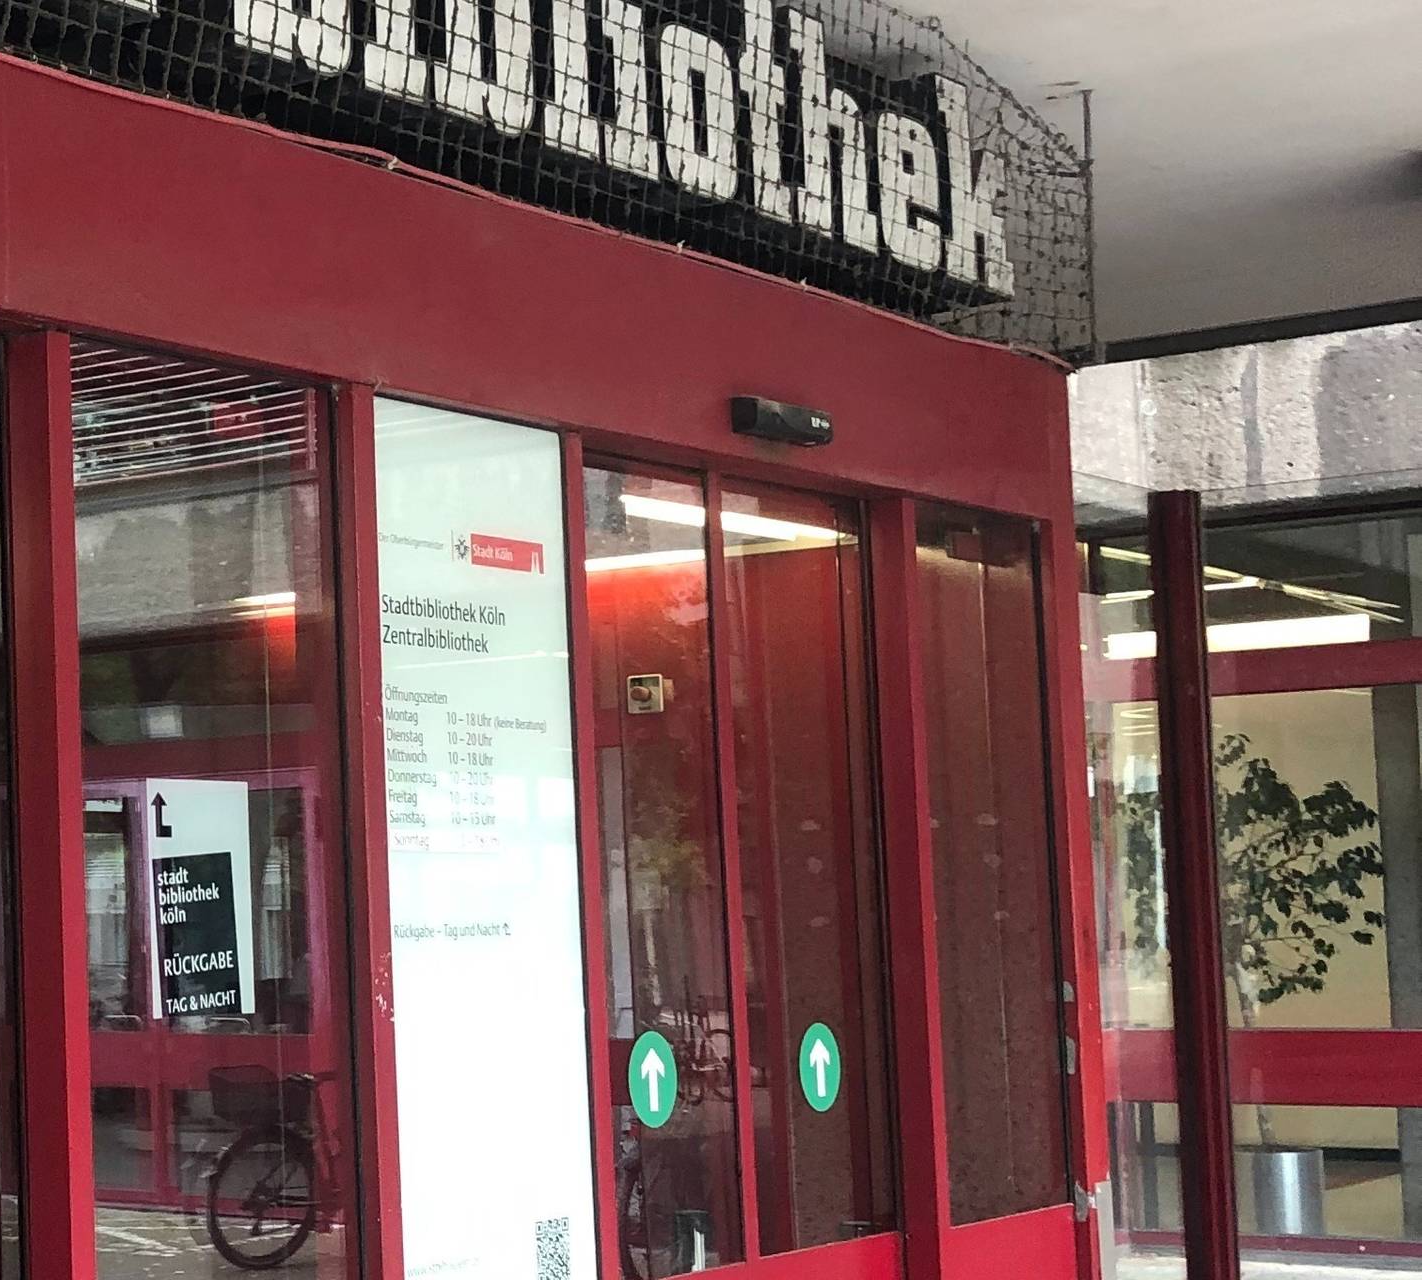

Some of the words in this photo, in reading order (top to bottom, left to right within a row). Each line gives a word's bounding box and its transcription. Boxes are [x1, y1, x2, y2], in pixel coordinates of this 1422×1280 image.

[471, 543, 494, 559] Stadt
[494, 545, 514, 561] Köln
[381, 594, 477, 624] Stadtbibliothek
[479, 605, 506, 627] Köln
[382, 624, 489, 654] Zentralbibliothek
[384, 684, 448, 706] Öffnungszeiten
[385, 708, 418, 726] Montag
[446, 711, 457, 725] 10
[465, 713, 476, 726] 18
[477, 714, 493, 727] Uhr
[386, 727, 424, 747] Dienstag
[447, 731, 458, 745] 10
[466, 732, 477, 746] 20
[478, 733, 493, 747] Uhr
[387, 748, 428, 764] Mittwoch
[448, 751, 459, 765] 10
[467, 752, 478, 766] 18
[479, 753, 494, 767] Uhr
[387, 768, 437, 787] Donnerstag
[388, 788, 418, 807] Freitag
[389, 809, 427, 828] Samstag
[157, 867, 189, 887] stadt
[159, 883, 220, 906] bibliothek
[160, 906, 187, 926] köln
[393, 924, 435, 942] Rückgabe
[443, 923, 459, 941] Tag
[459, 923, 476, 937] und
[477, 922, 501, 937] Nacht
[164, 950, 235, 978] RÜCKGABE
[166, 996, 188, 1015] TAG
[189, 995, 199, 1011] &
[199, 989, 237, 1011] NACHT
